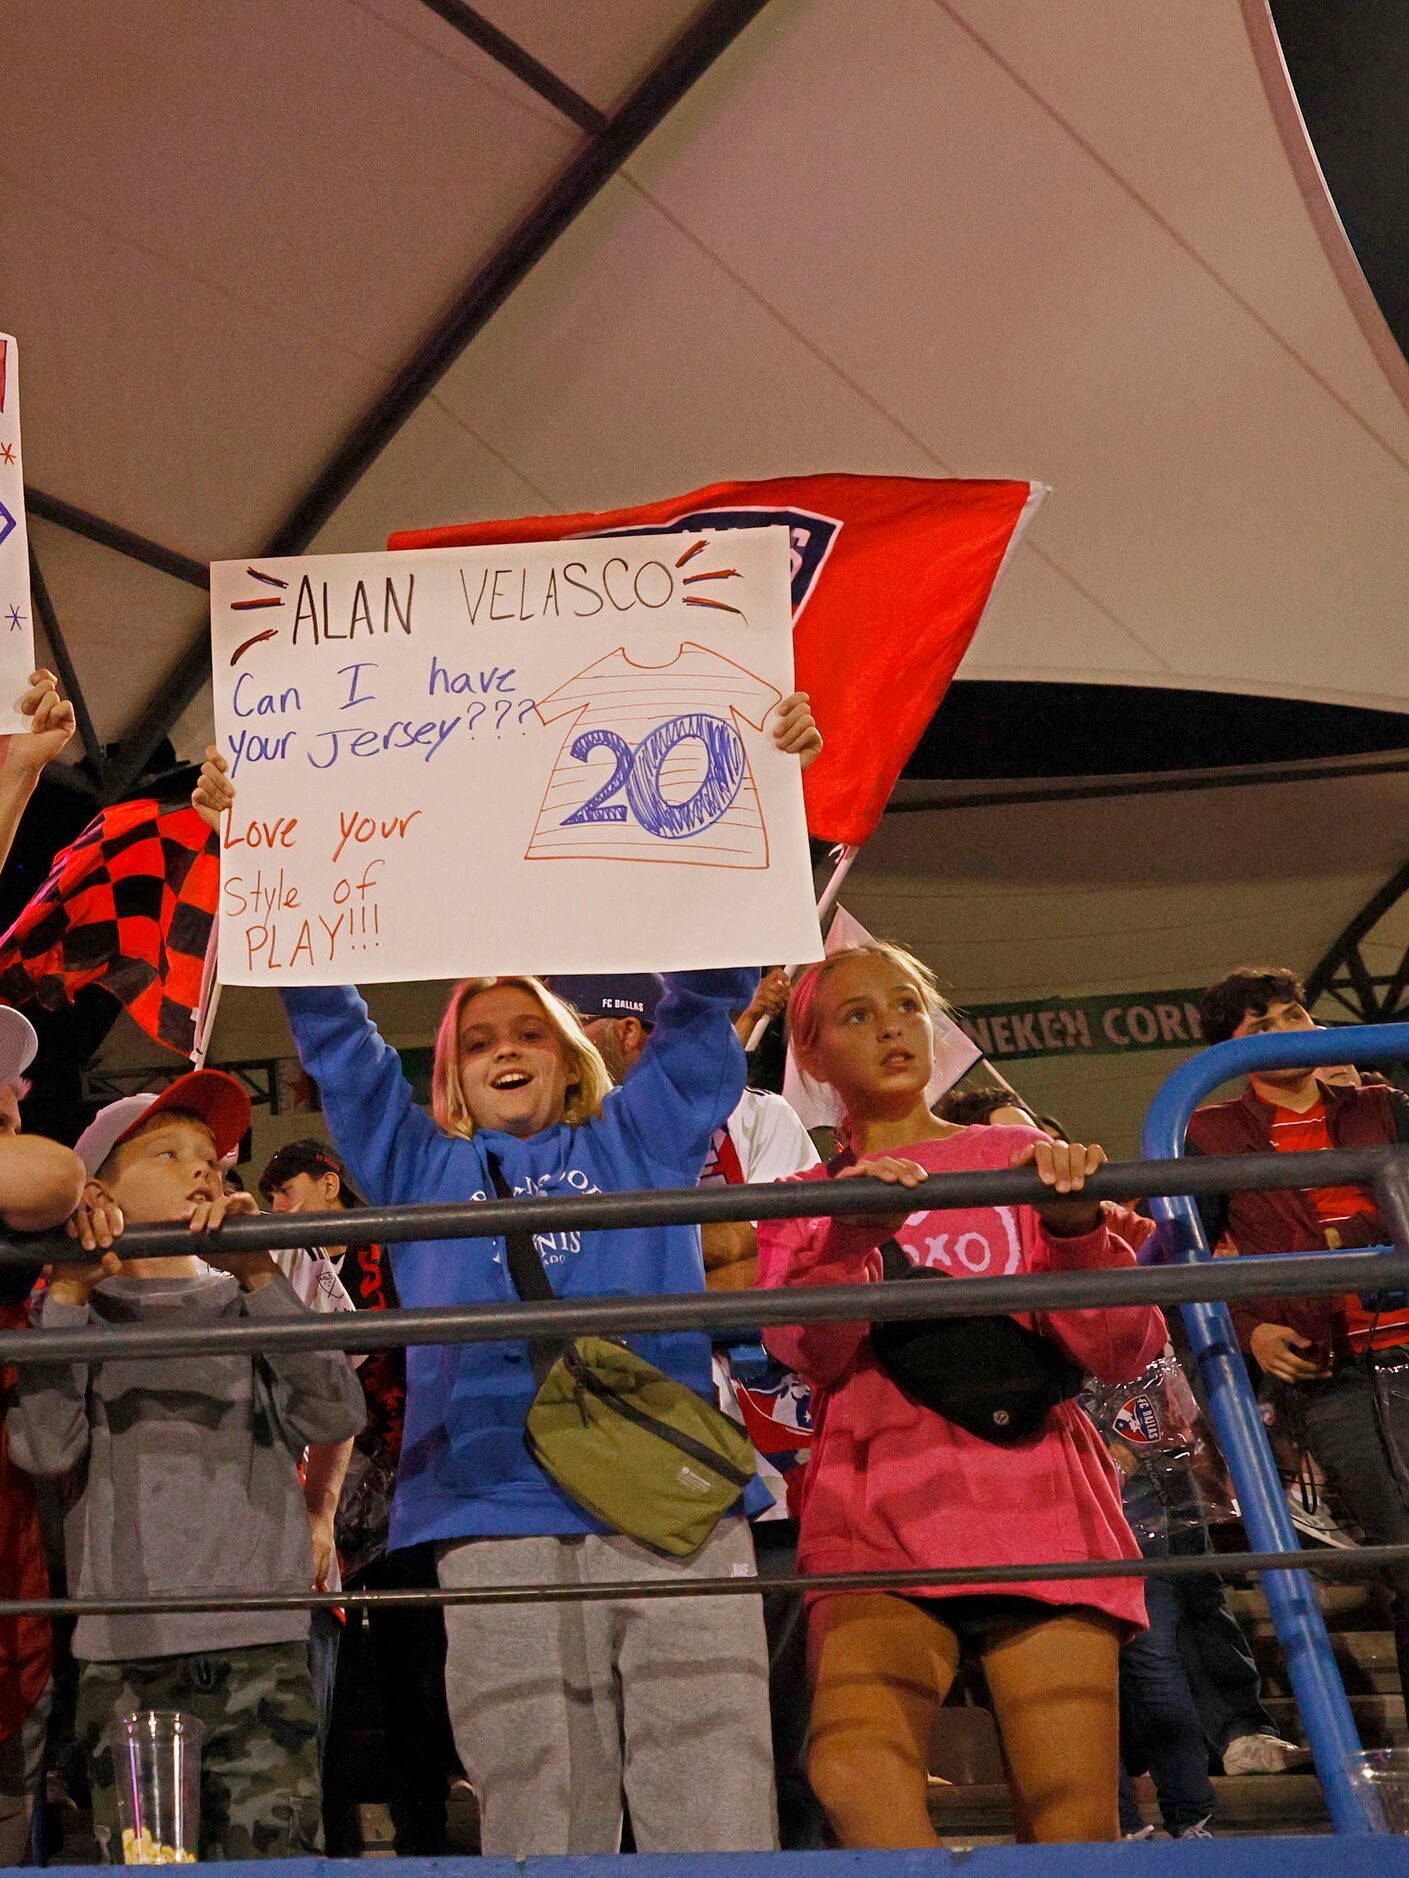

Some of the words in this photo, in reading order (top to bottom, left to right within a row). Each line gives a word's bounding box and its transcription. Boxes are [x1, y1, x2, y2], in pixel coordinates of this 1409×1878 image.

[291, 574, 416, 647] ALAN
[460, 560, 674, 625] VELASCO
[232, 672, 302, 719] Can
[338, 661, 379, 709] I
[428, 656, 517, 696] have
[228, 727, 291, 779] your
[306, 698, 537, 769] Jersey???
[559, 712, 748, 840] 20
[224, 809, 297, 851] Love
[332, 809, 423, 862] your
[224, 868, 302, 927] Style
[333, 859, 386, 903] of
[245, 904, 381, 972] PLAY!!!
[602, 998, 613, 1009] FC
[614, 999, 644, 1012] DALLAS
[963, 1010, 1093, 1051] NEKEN
[1136, 1397, 1148, 1409] FC
